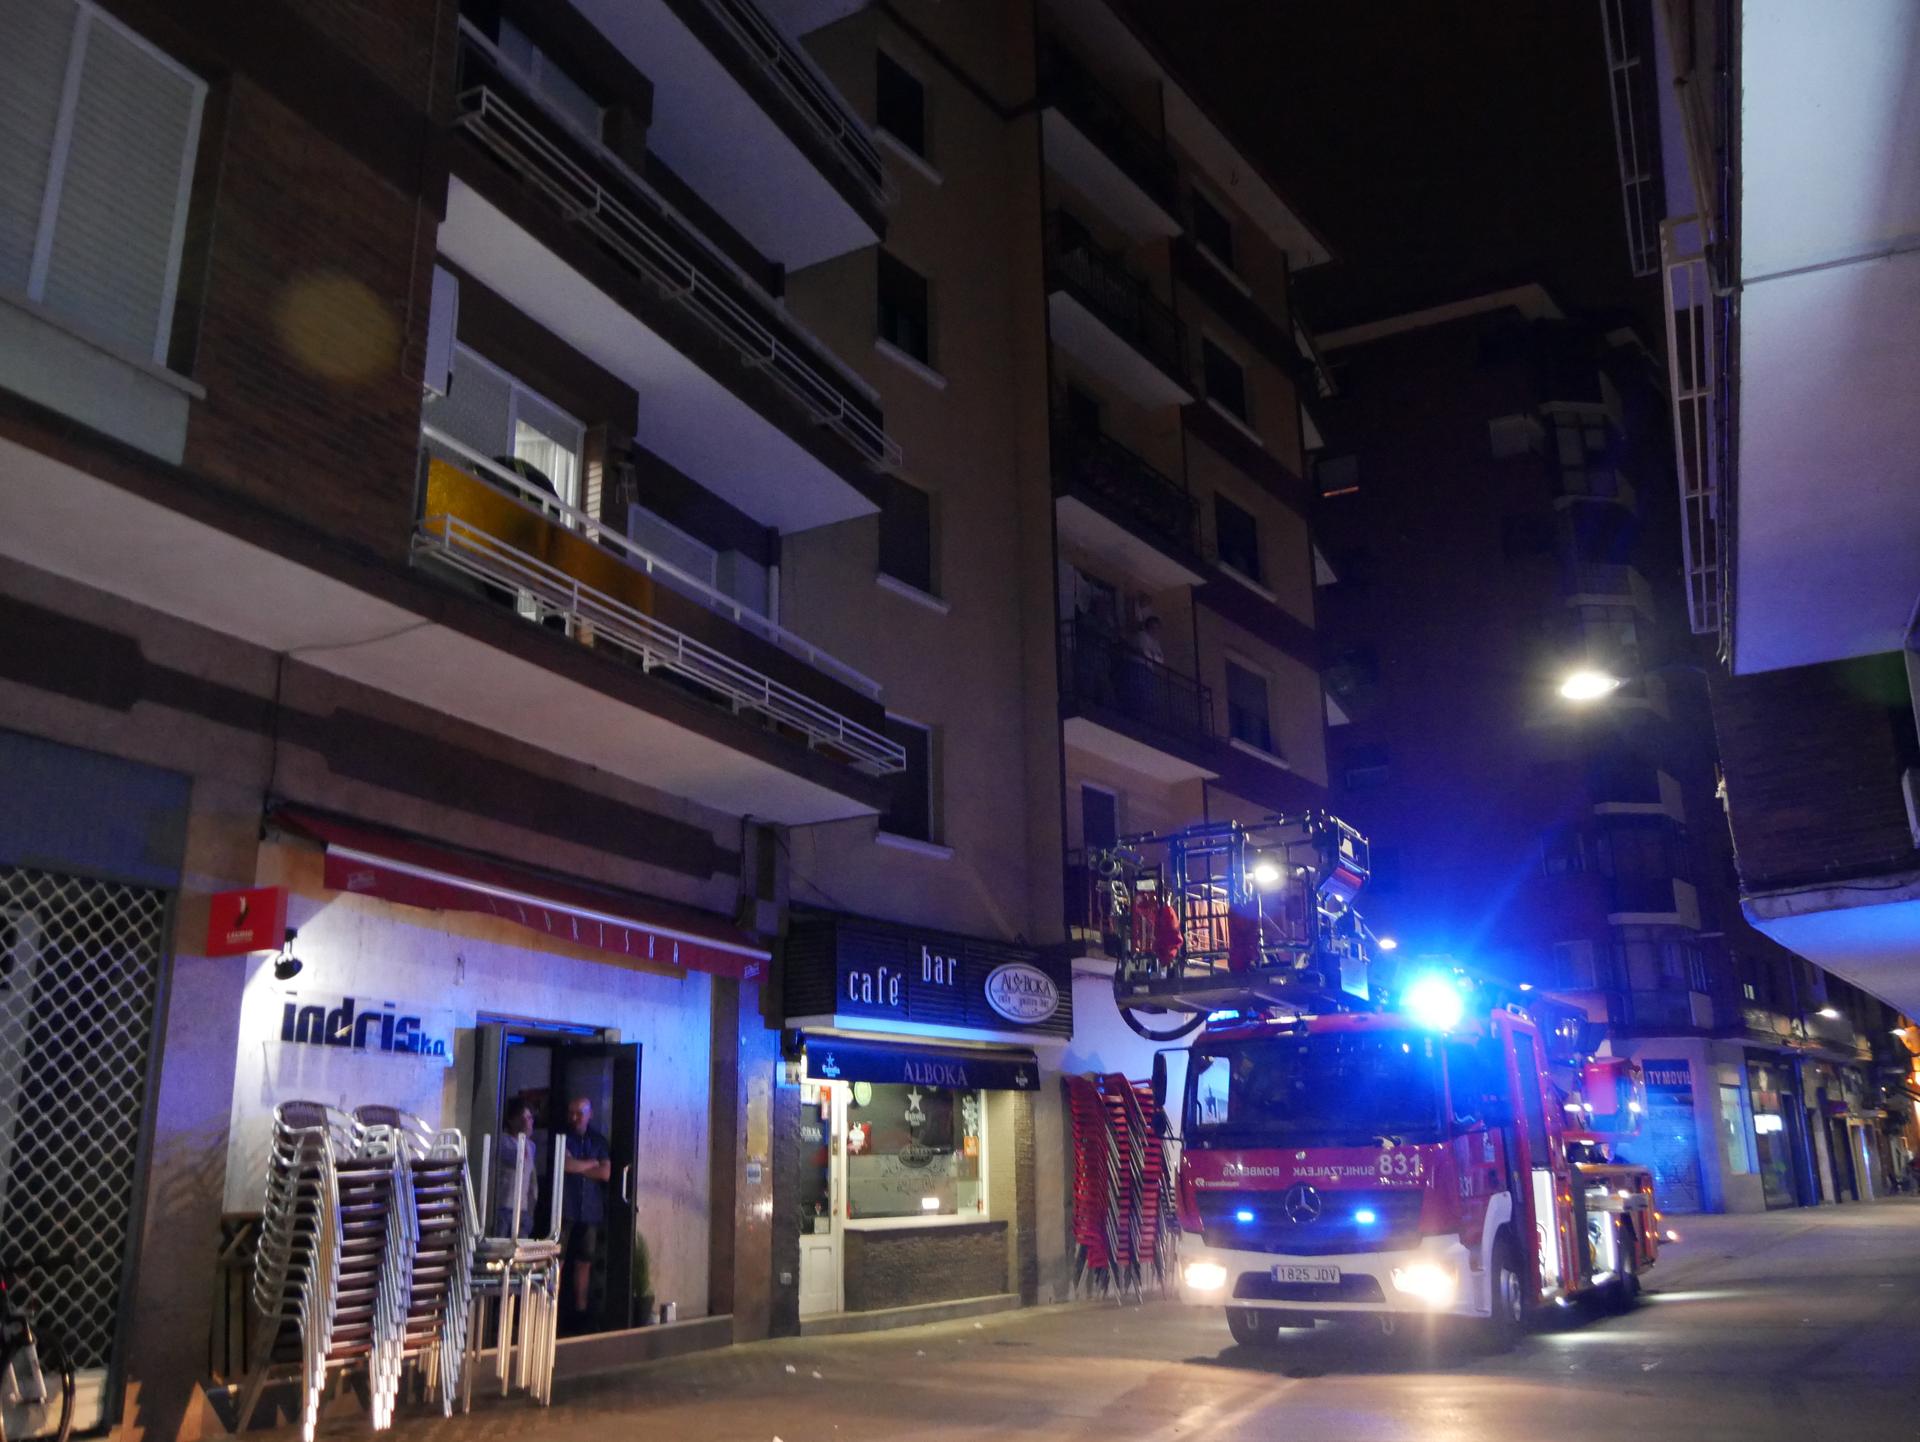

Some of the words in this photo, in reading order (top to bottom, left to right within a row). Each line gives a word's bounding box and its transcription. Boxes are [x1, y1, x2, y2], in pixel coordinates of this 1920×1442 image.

[921, 944, 957, 986] bar
[848, 965, 902, 1007] café
[903, 1059, 969, 1086] ALBOKA
[1379, 1153, 1421, 1176] 831
[1281, 1267, 1311, 1281] 1825
[1314, 1267, 1336, 1282] JDV
